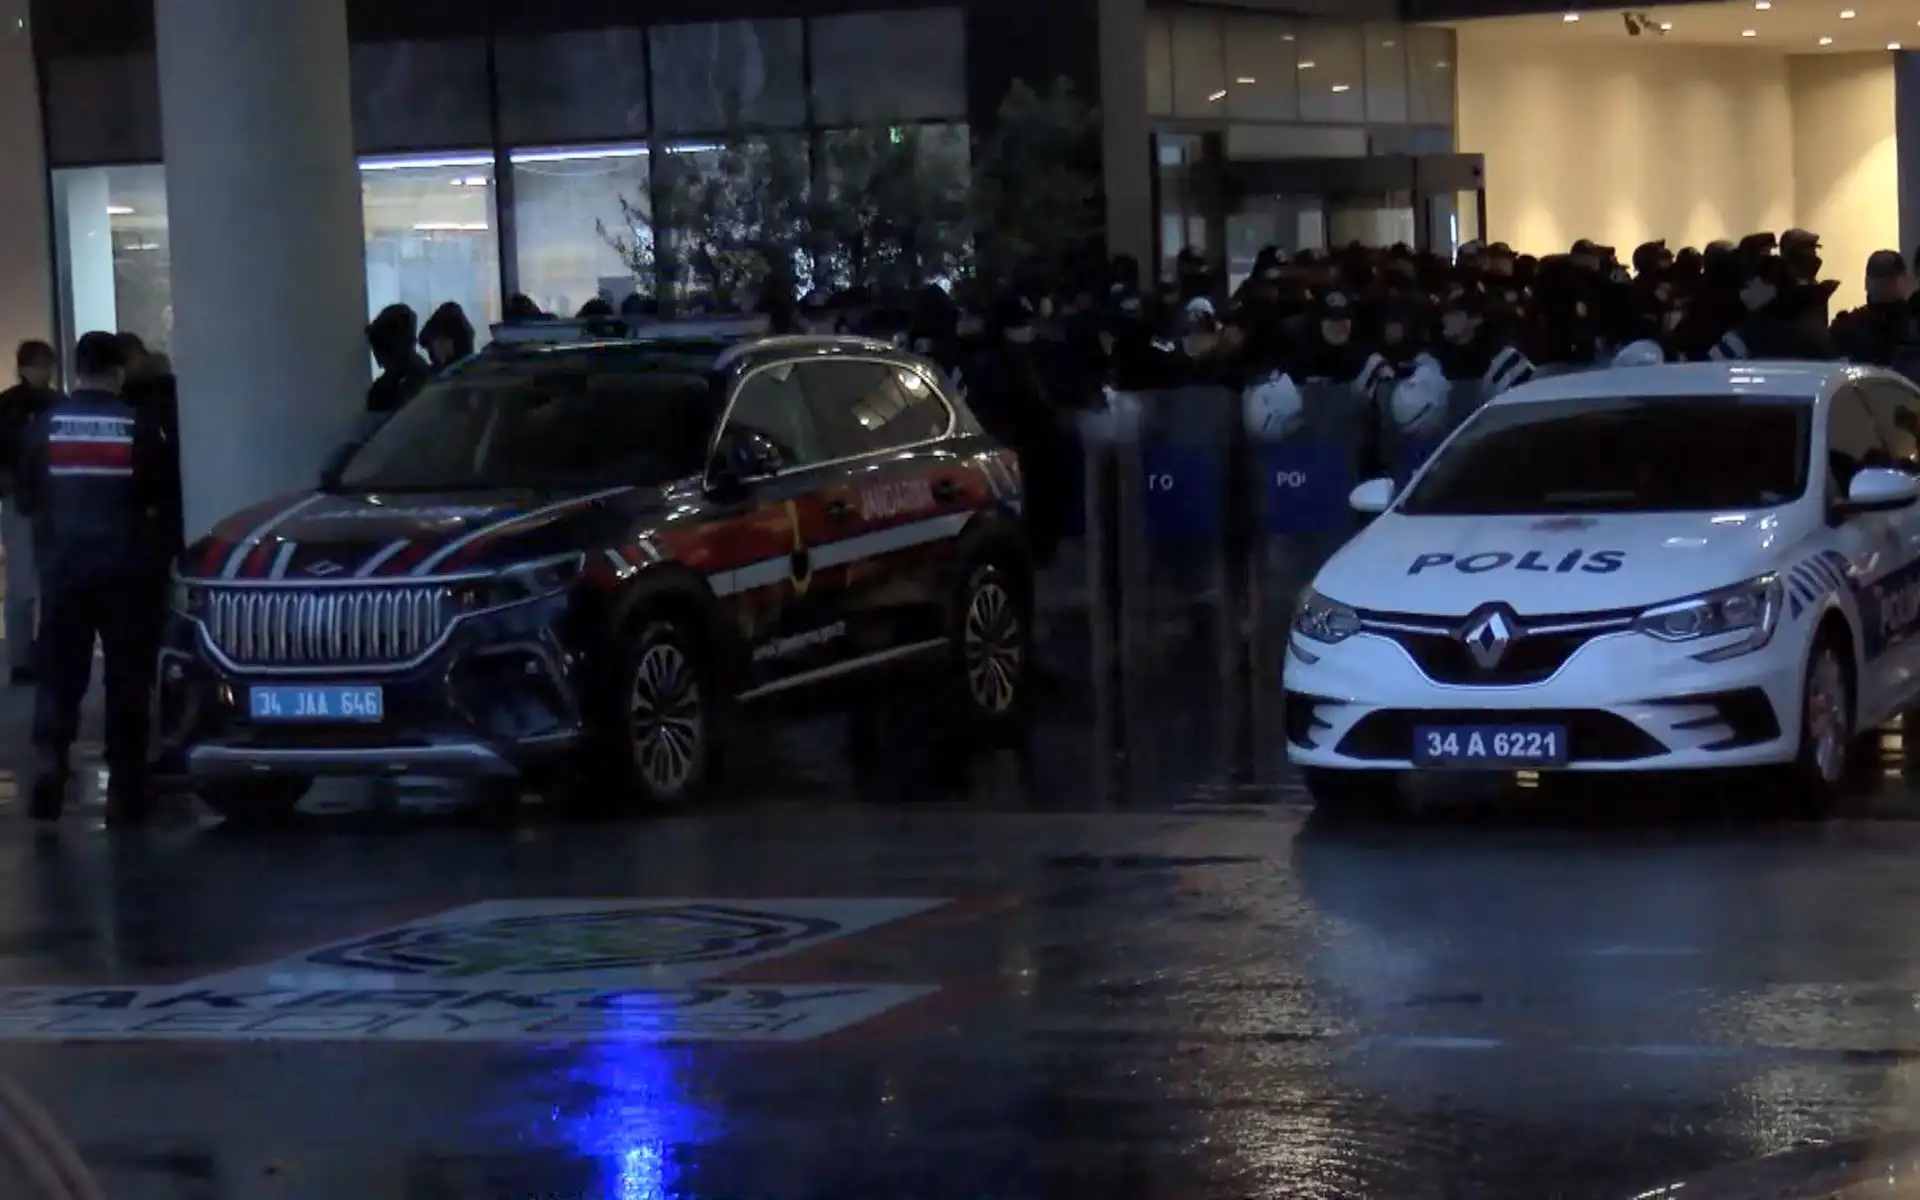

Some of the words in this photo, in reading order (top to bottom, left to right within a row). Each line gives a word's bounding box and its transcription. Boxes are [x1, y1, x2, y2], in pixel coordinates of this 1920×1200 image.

[258, 692, 282, 716] 34
[295, 691, 329, 715] JAA
[340, 691, 377, 716] 646
[1427, 731, 1460, 757] 34
[1466, 731, 1487, 757] A
[1493, 731, 1556, 757] 6221
